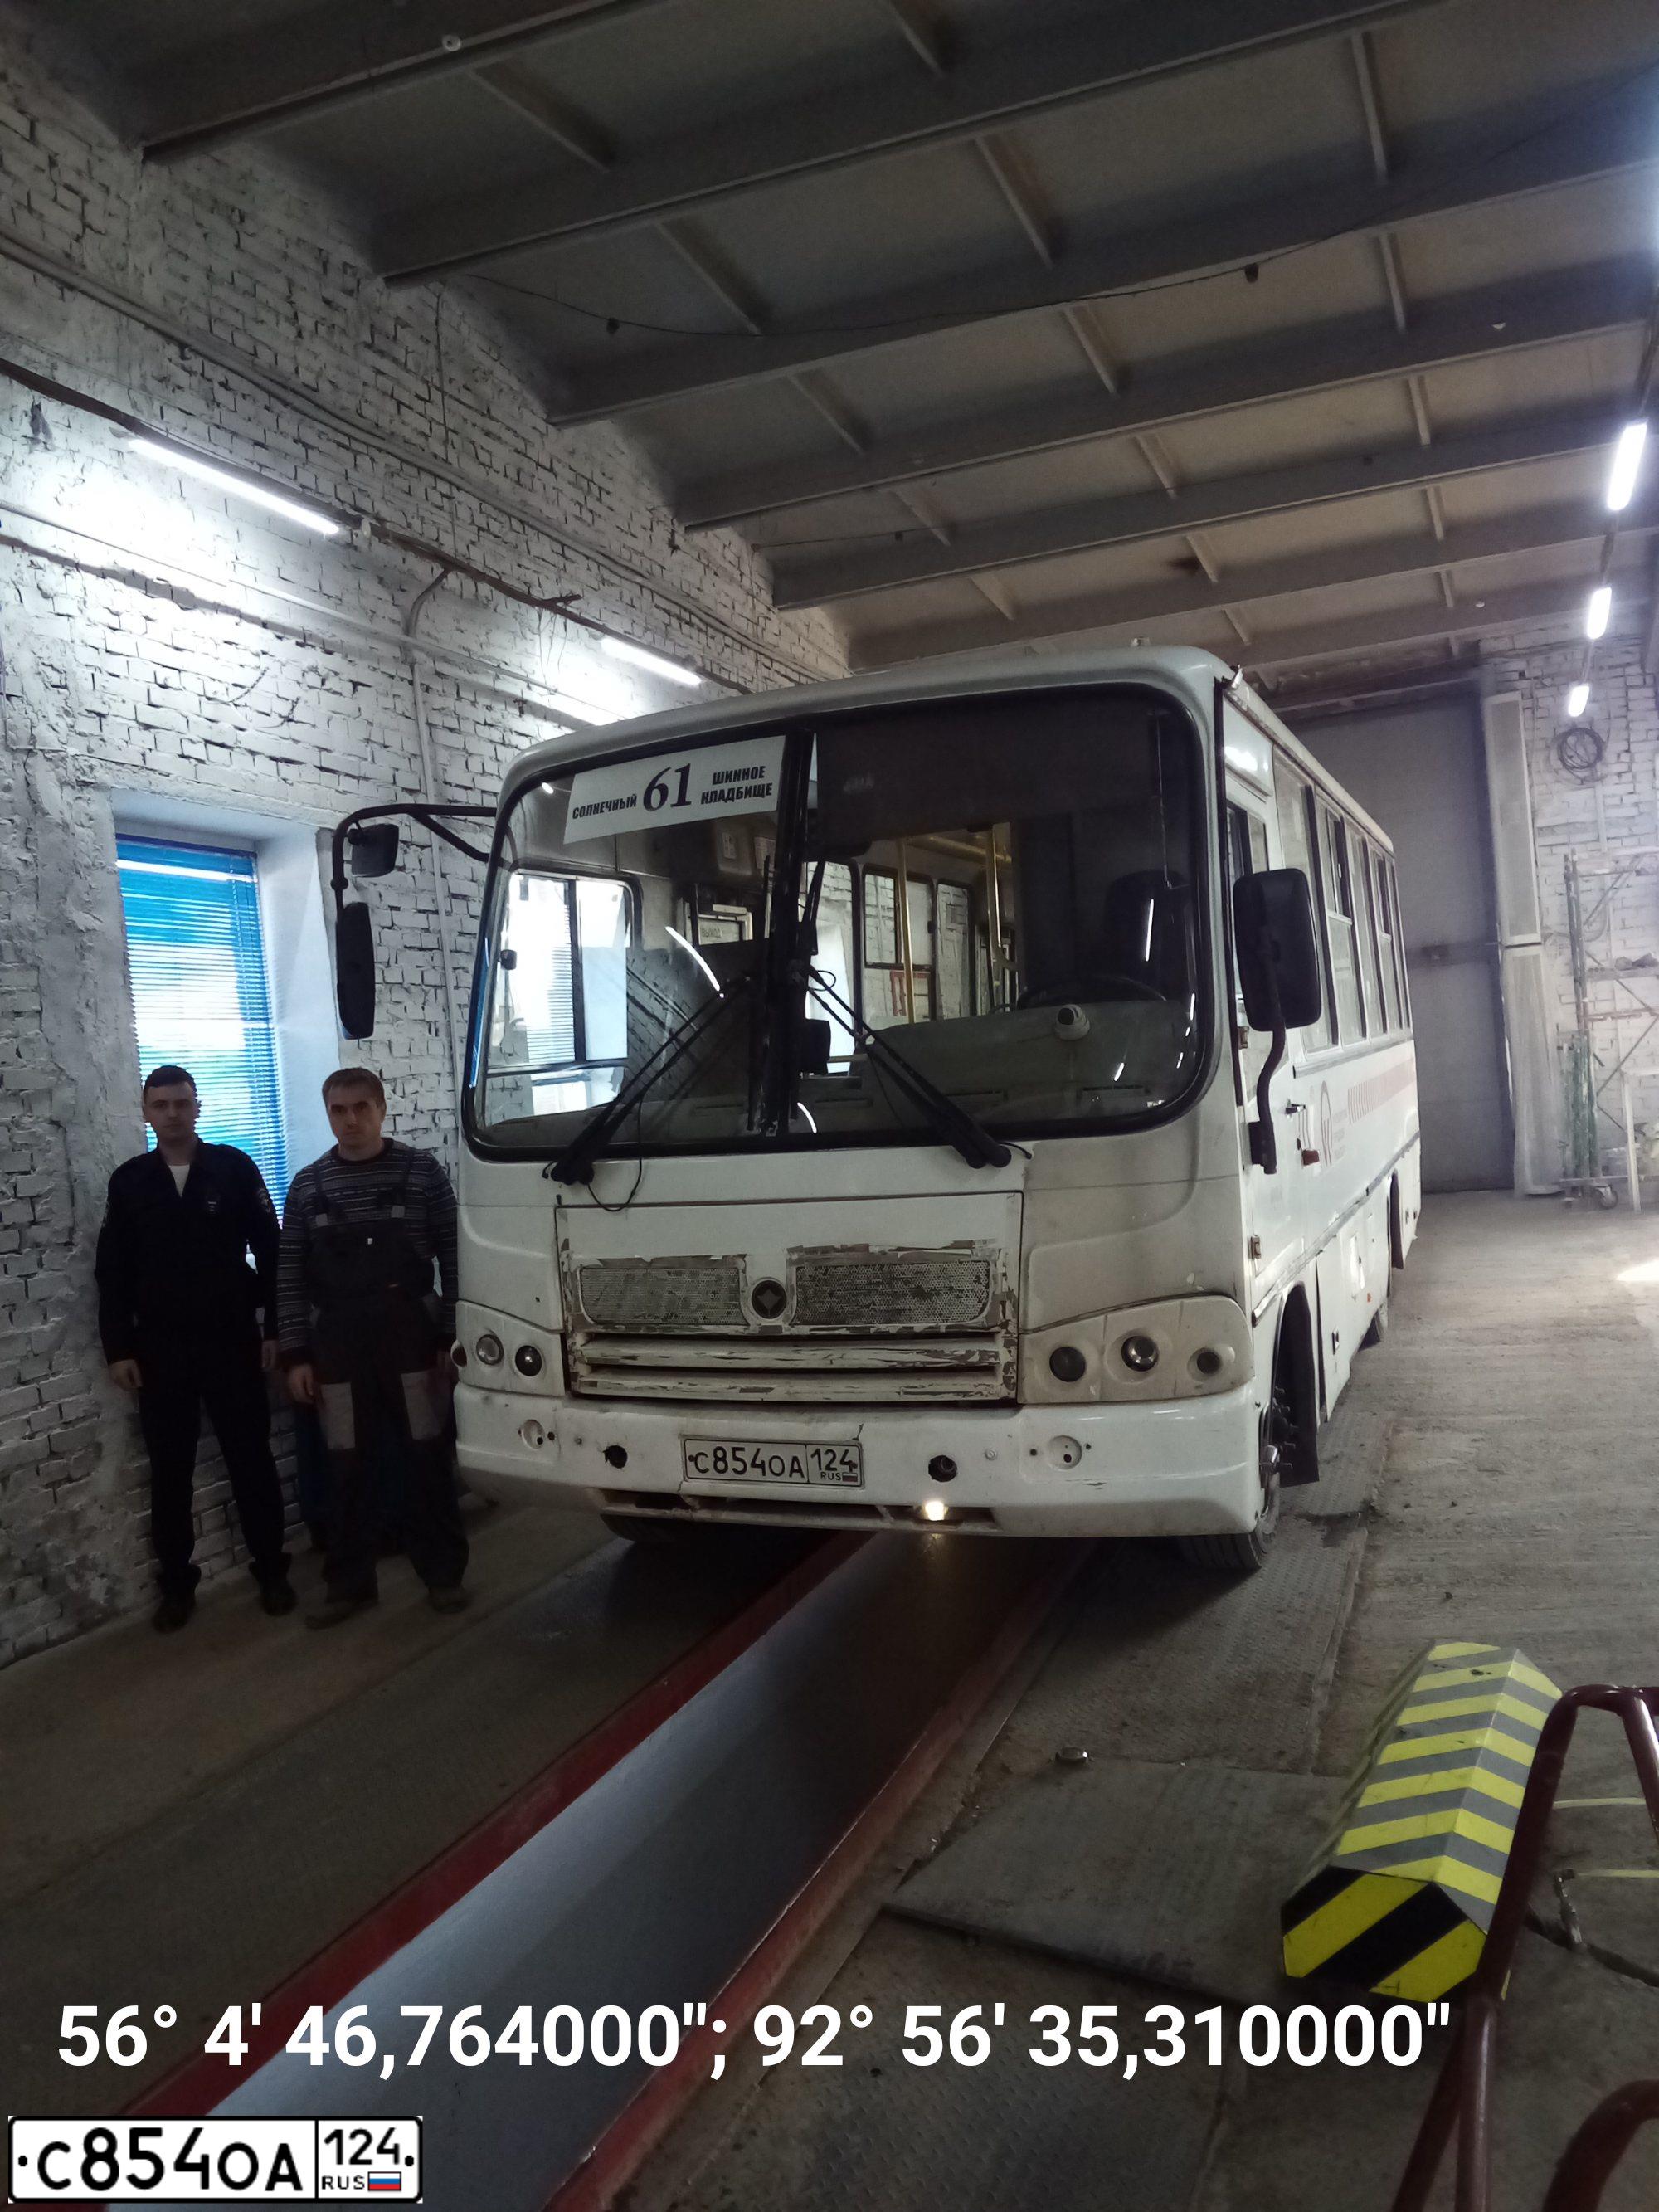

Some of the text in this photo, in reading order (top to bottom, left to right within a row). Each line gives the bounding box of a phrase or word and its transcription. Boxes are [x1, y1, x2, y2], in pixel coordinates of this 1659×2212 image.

[712, 765, 766, 786] ШИННОЕ
[643, 763, 692, 812] 61
[701, 782, 772, 805] КЛАДБИЩЕ
[572, 793, 637, 820] СОЛНЕЧНЫЙ
[820, 1471, 842, 1481] RUS
